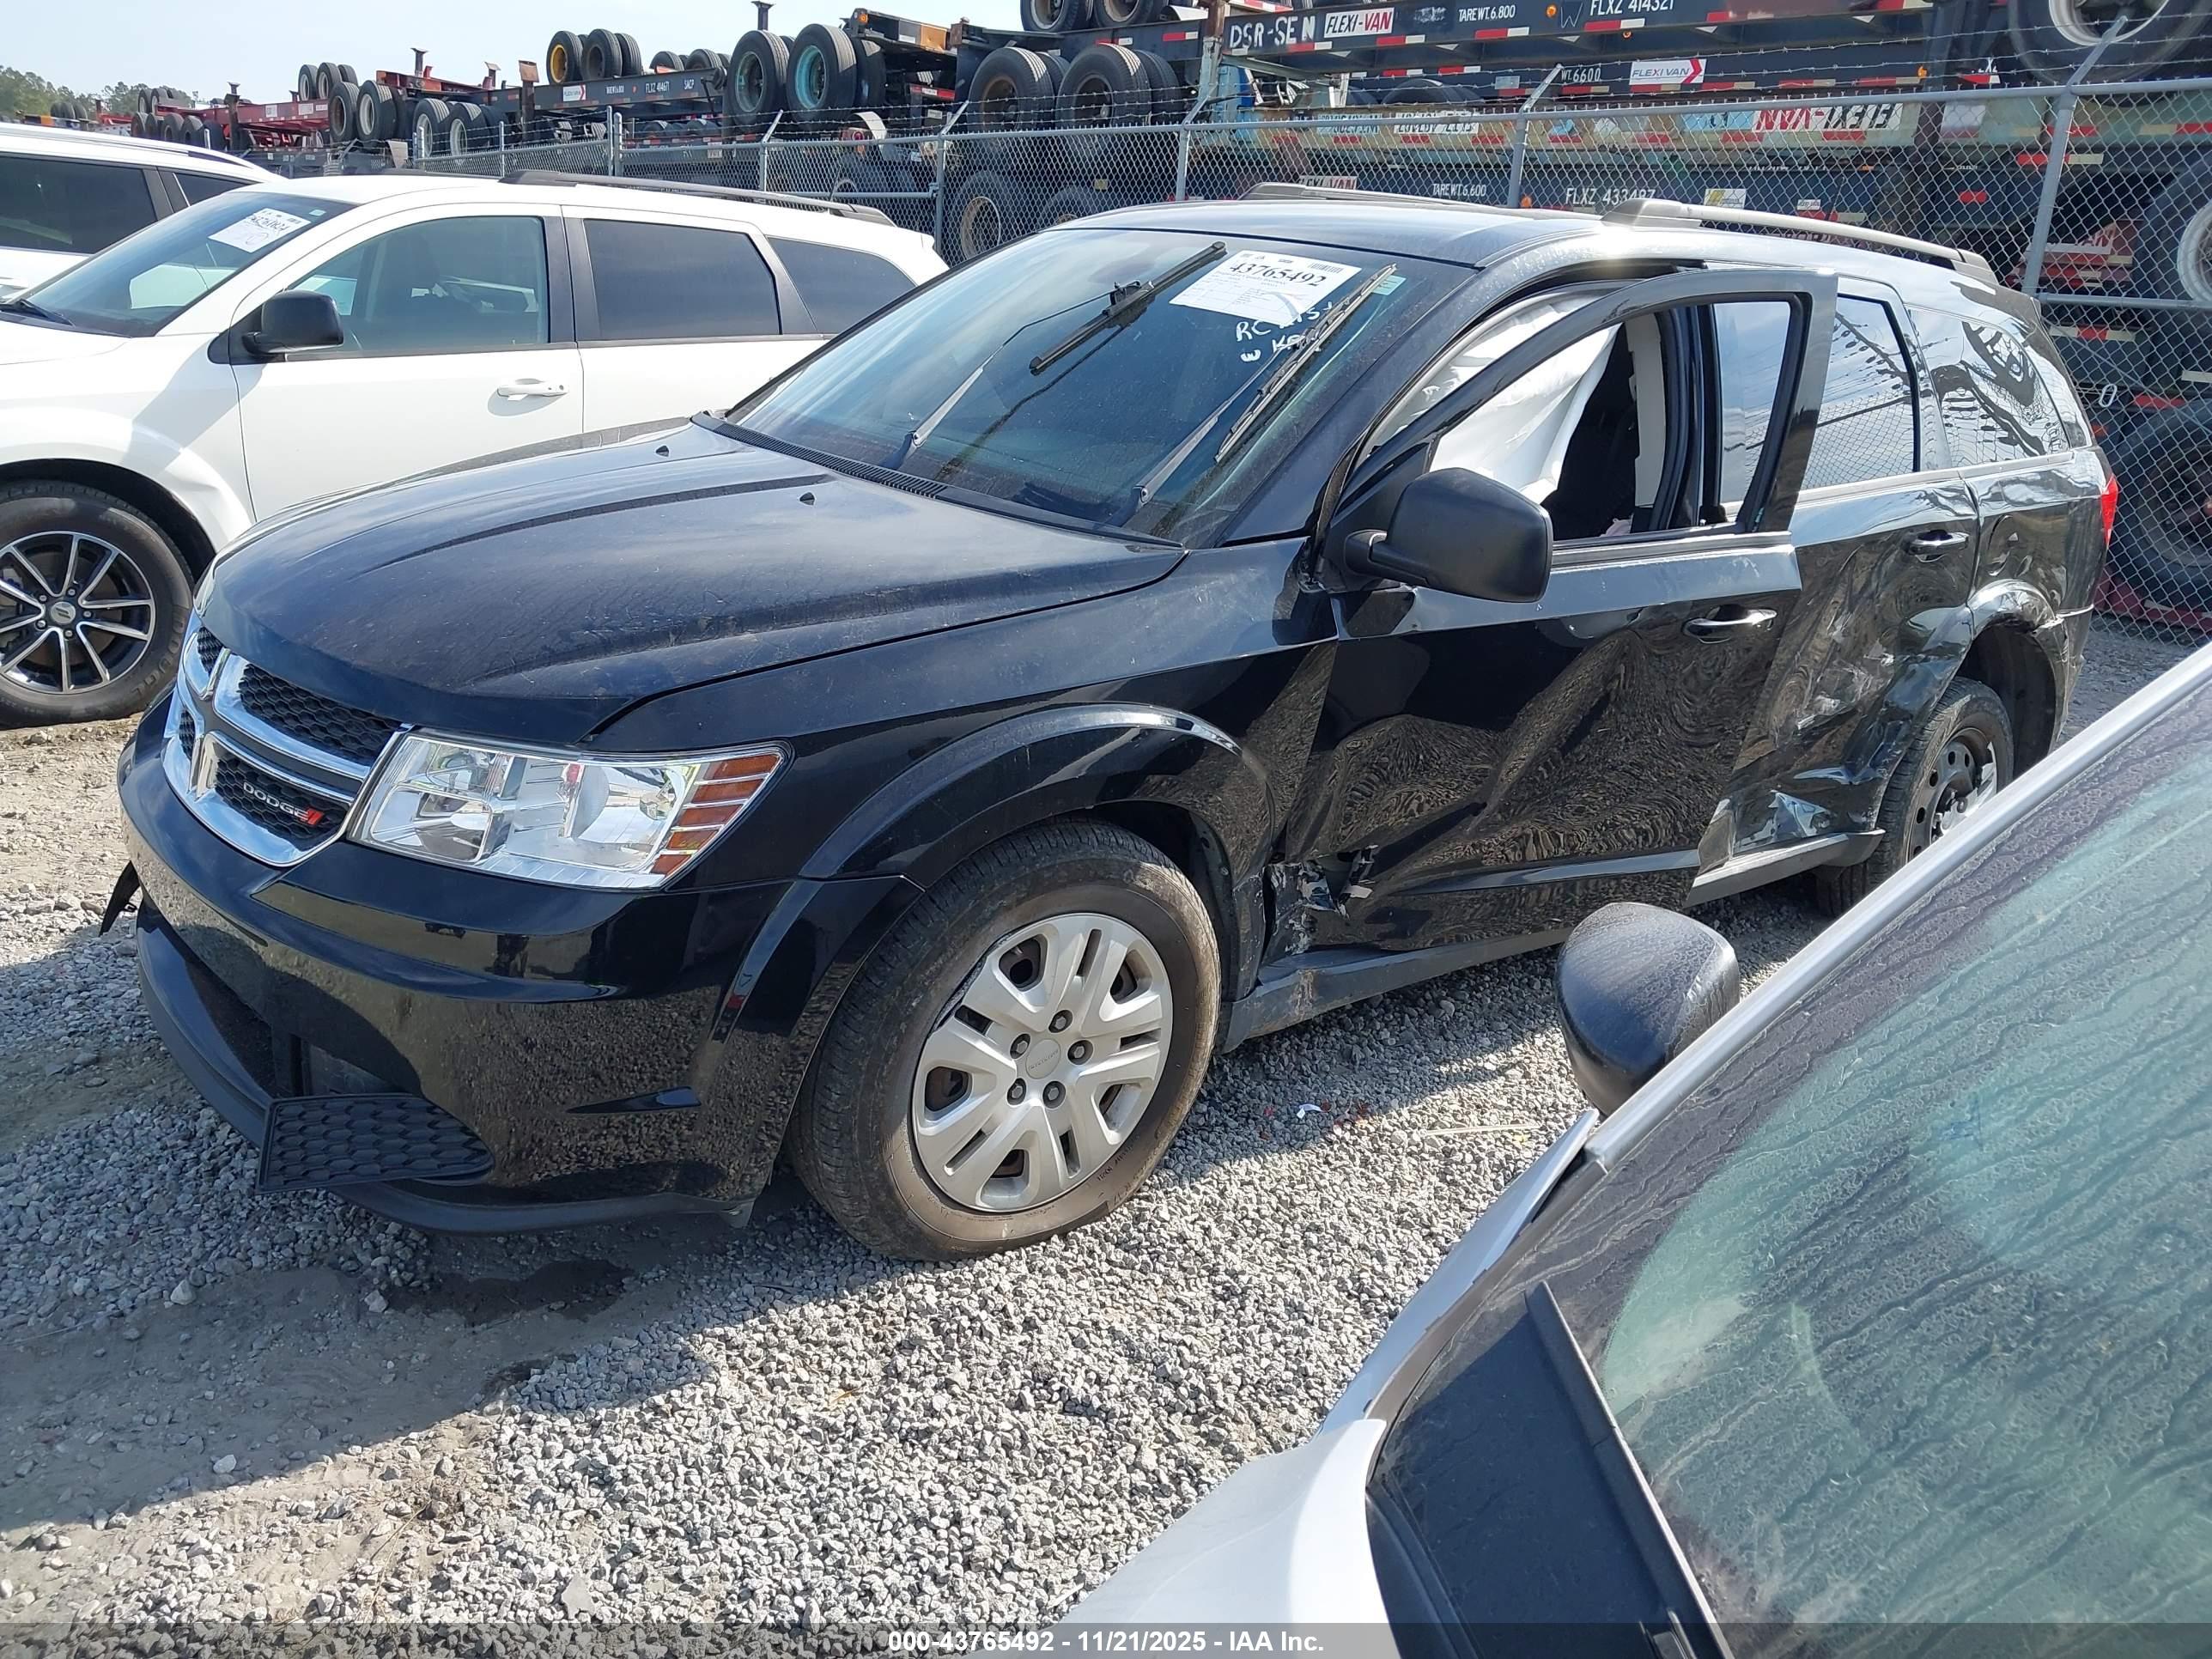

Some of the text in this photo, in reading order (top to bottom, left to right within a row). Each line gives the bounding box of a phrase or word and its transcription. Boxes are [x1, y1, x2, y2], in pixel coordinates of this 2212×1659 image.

[1589, 0, 1623, 16] FLXZ
[1326, 11, 1392, 33] FLEXI-VAN
[1632, 69, 1664, 77] FLEXI
[1230, 262, 1327, 287] 43765492
[243, 781, 309, 822] DODGE
